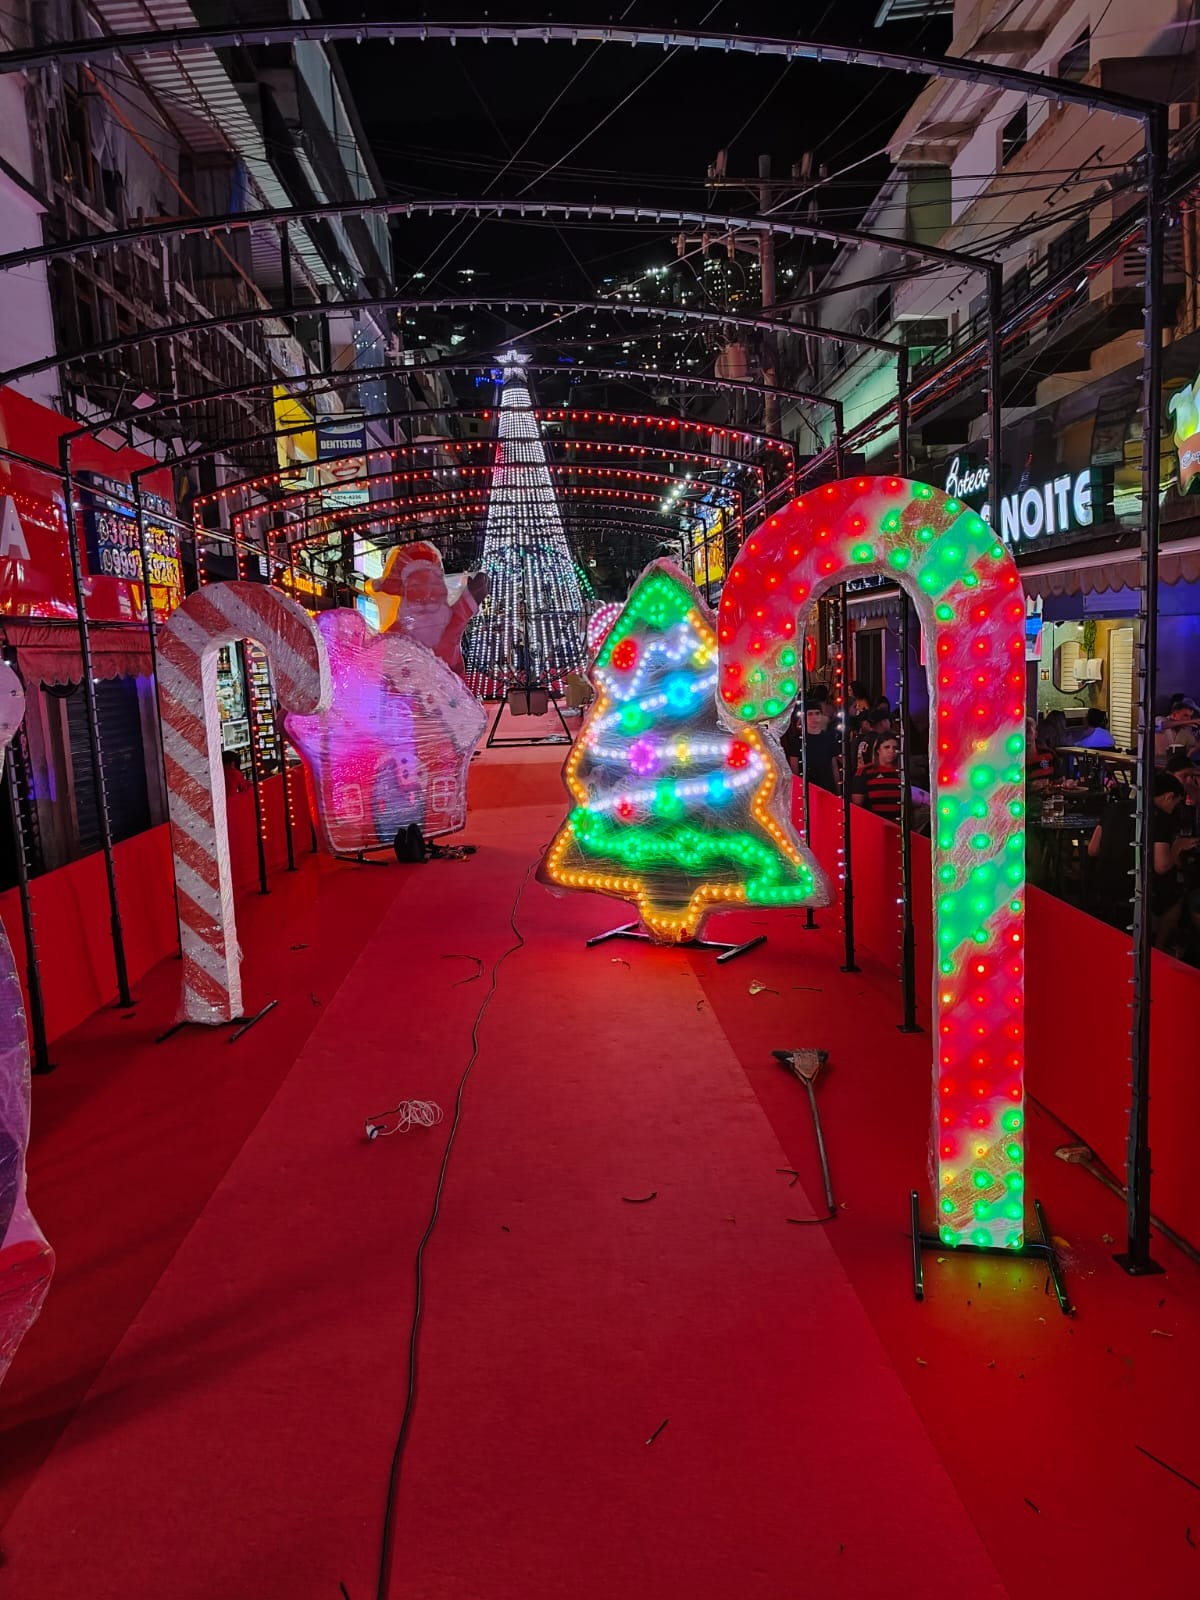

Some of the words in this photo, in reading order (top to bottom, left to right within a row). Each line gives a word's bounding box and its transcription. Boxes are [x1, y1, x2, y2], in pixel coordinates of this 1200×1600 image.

[320, 439, 363, 450] DENTISTAS
[945, 456, 991, 499] Boteco
[1000, 468, 1094, 543] NOITE
